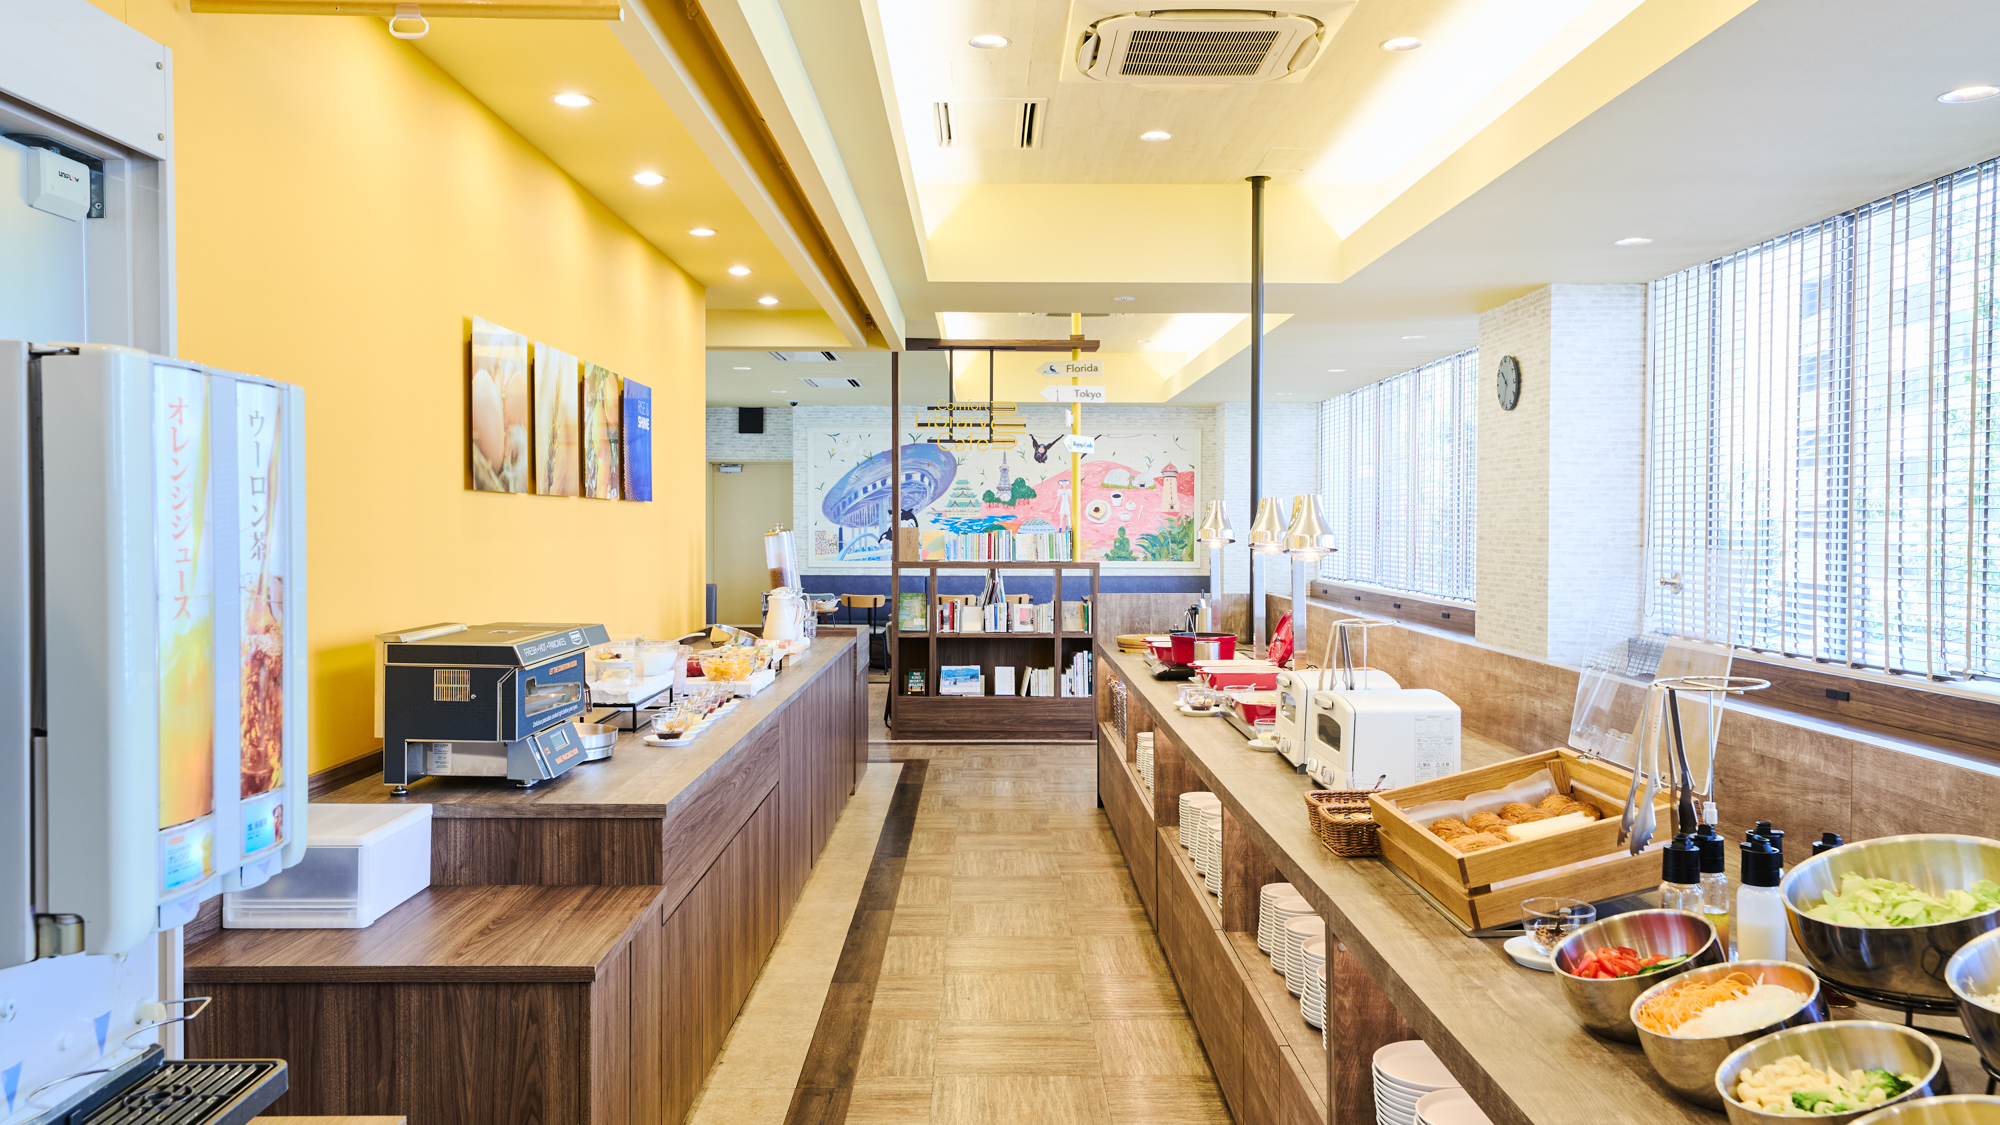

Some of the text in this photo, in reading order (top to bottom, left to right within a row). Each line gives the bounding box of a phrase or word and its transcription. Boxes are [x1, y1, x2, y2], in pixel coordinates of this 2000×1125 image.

[1066, 363, 1099, 373] Florida
[1074, 389, 1102, 400] Tokyo
[937, 399, 989, 411] Comfort
[916, 409, 989, 435] Library
[937, 431, 989, 451] Cafe
[249, 410, 268, 561] ウーロン茶
[168, 396, 192, 622] オレンジジュース
